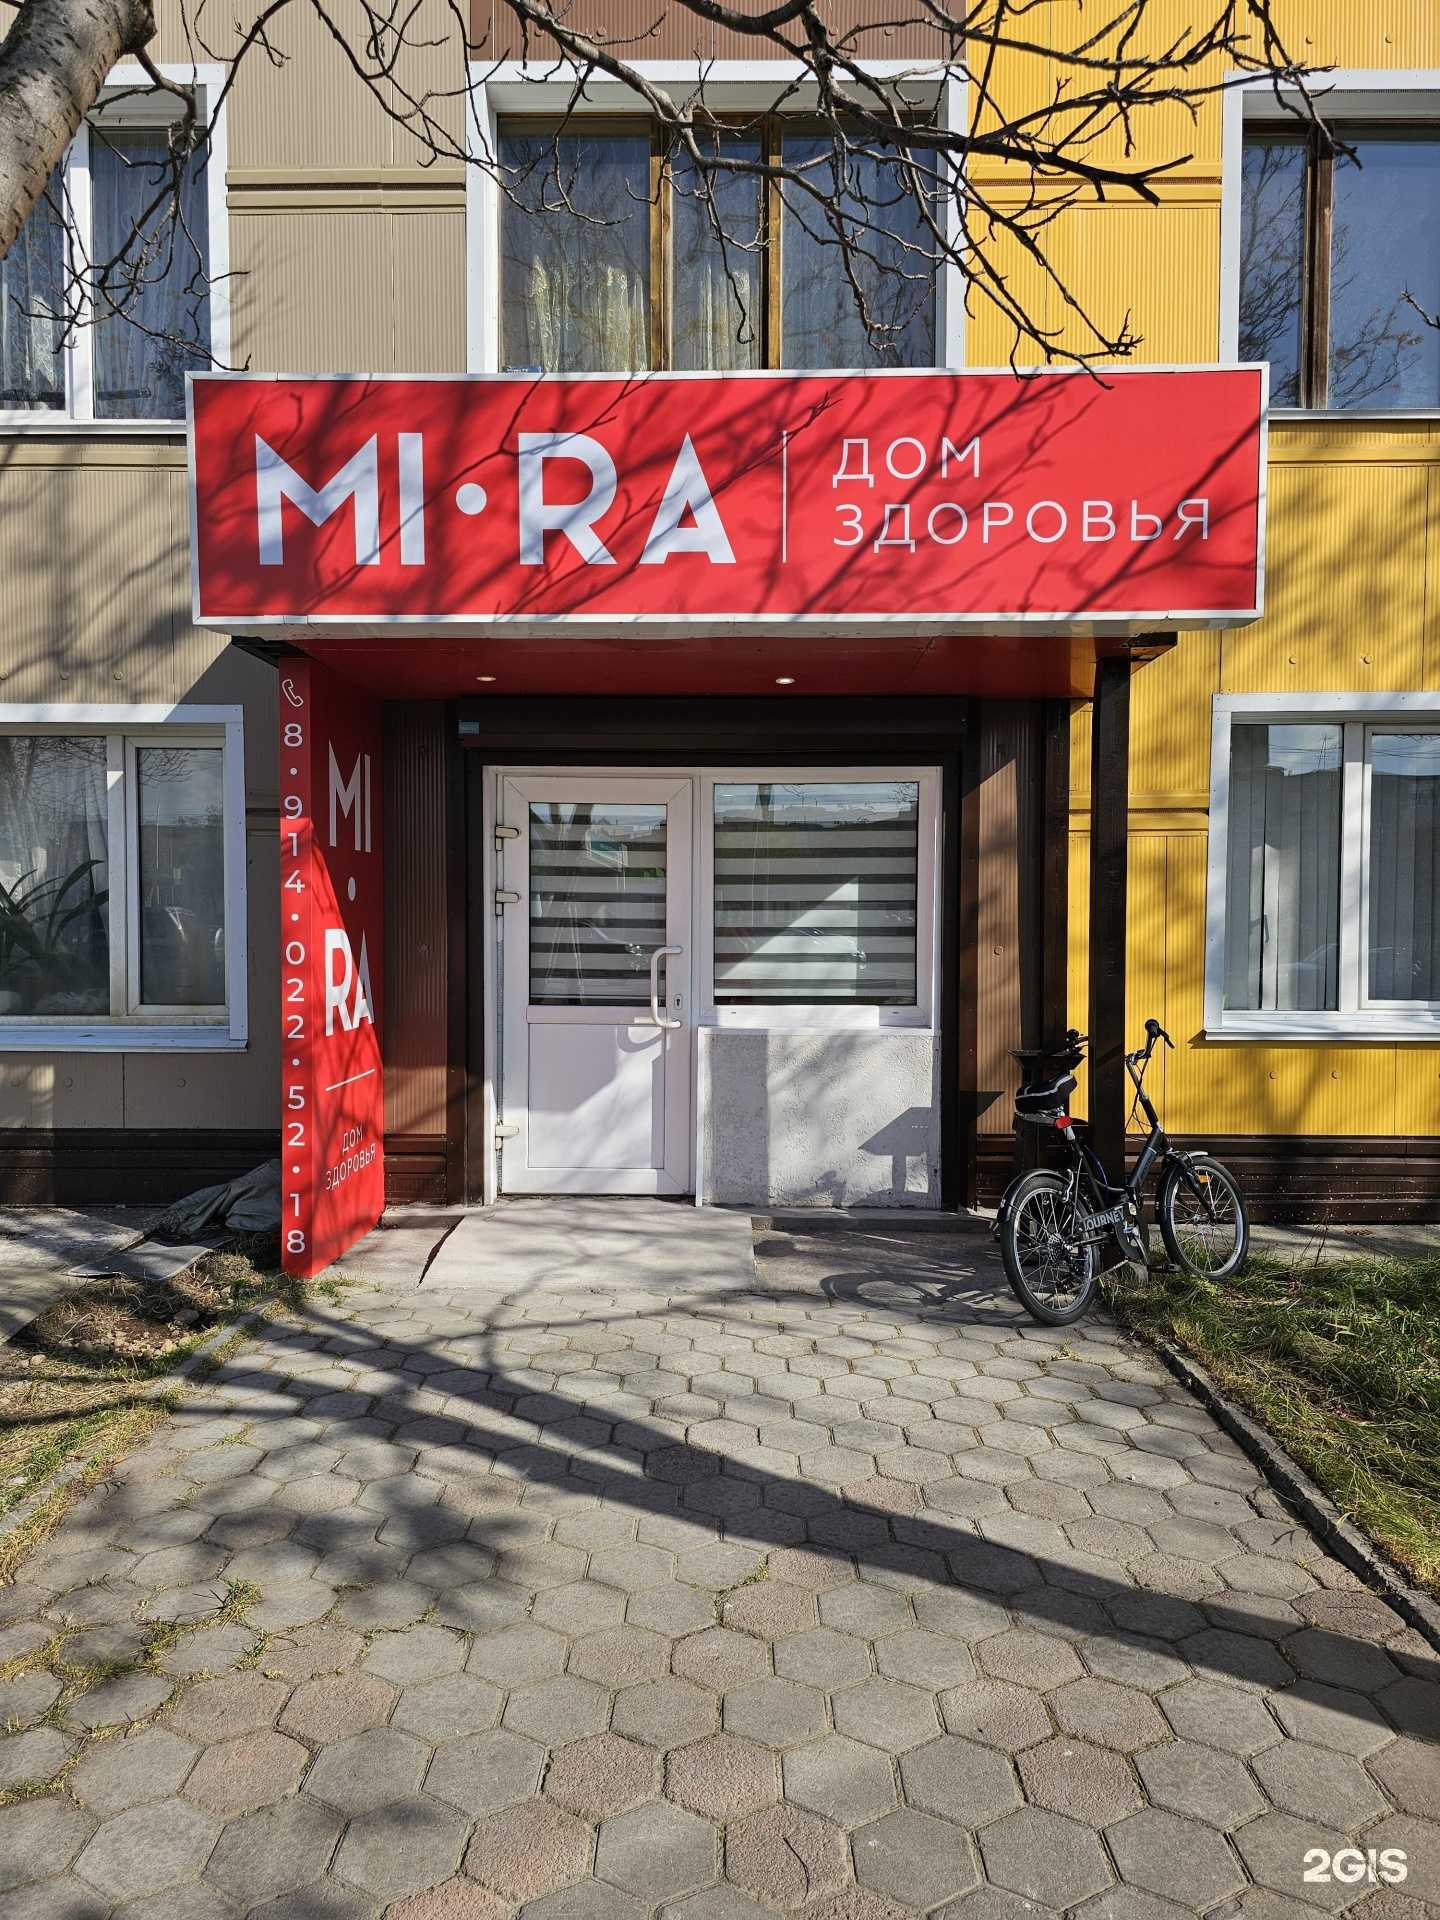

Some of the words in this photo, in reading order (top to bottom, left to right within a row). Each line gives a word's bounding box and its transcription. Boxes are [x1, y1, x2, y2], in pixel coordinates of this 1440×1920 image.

[833, 437, 980, 489] ДОМ
[834, 499, 1209, 554] ЗДОРОВЬЯ
[342, 1126, 363, 1154] ДОМ
[326, 1143, 376, 1191] ЗДОРОВЬЯ
